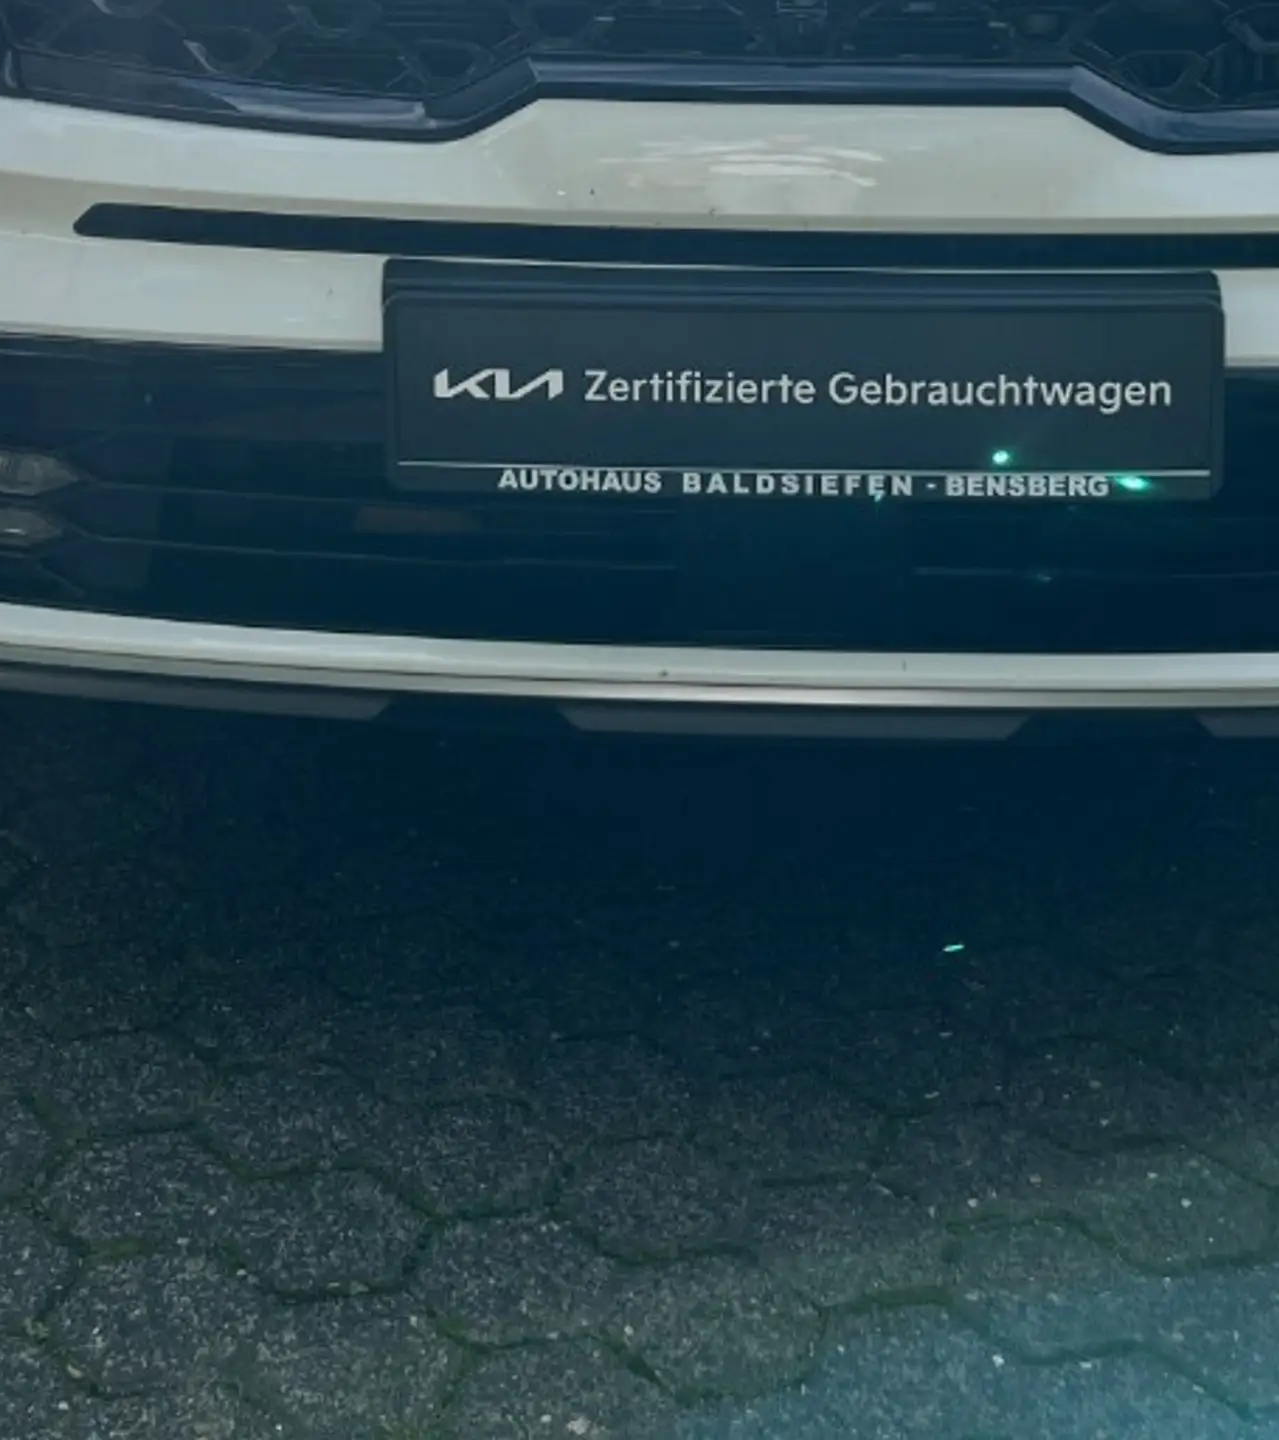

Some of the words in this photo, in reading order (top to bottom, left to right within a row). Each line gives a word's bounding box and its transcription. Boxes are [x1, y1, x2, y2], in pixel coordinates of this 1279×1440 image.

[433, 367, 564, 401] KIA
[583, 368, 816, 405] Zertifizierte
[828, 371, 1172, 415] Gebrauchtwagen
[497, 468, 662, 494] AUTOHAUS
[681, 471, 913, 497] BALDSIEFEN
[944, 474, 1110, 498] BENSBERG
